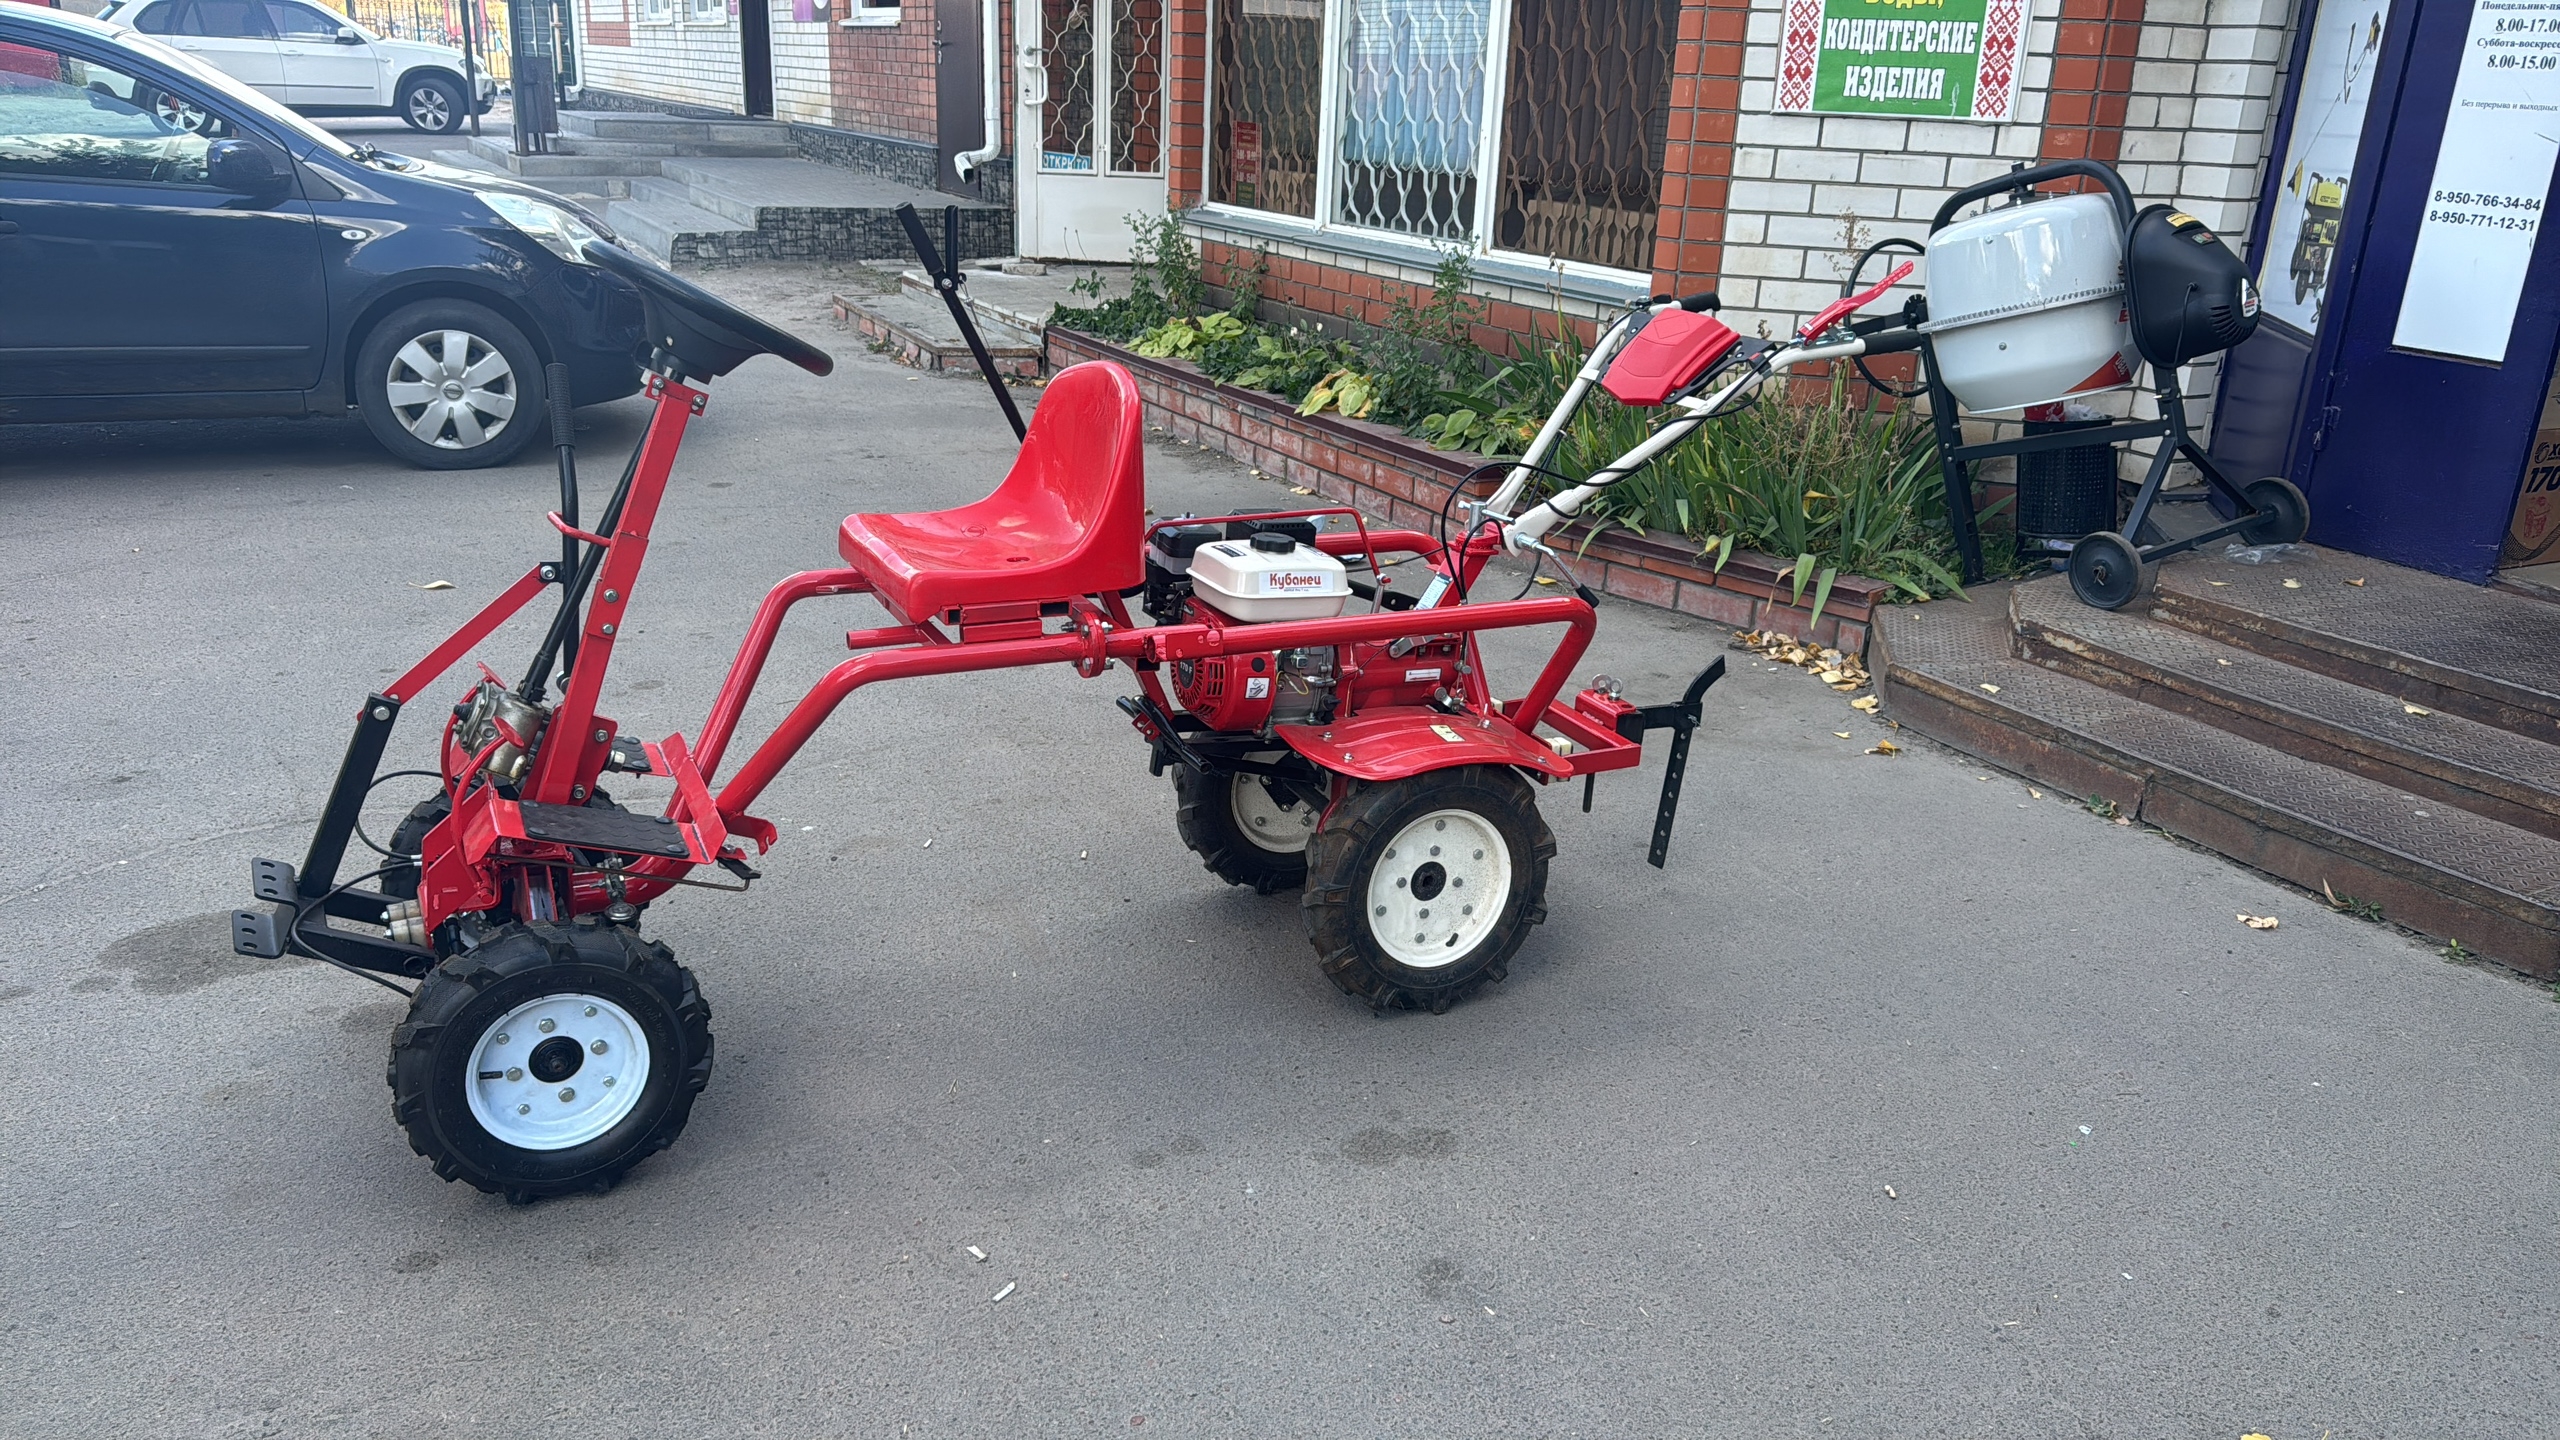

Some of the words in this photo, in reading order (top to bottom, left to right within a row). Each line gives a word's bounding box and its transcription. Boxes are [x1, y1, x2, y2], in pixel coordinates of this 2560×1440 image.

[1823, 18, 1980, 55] КОНДИТЕРСКИЕ
[2487, 54, 2557, 70] 8.00-15.00
[1842, 65, 1946, 102] ИЗДЕЛИЯ
[2461, 99, 2474, 108] Без
[2475, 101, 2511, 111] перерыва
[2519, 104, 2558, 112] выходных
[2434, 190, 2542, 212] 8-950-766-34-84
[2429, 210, 2536, 232] 8-950-771-12-31
[1270, 573, 1321, 589] Кубанец
